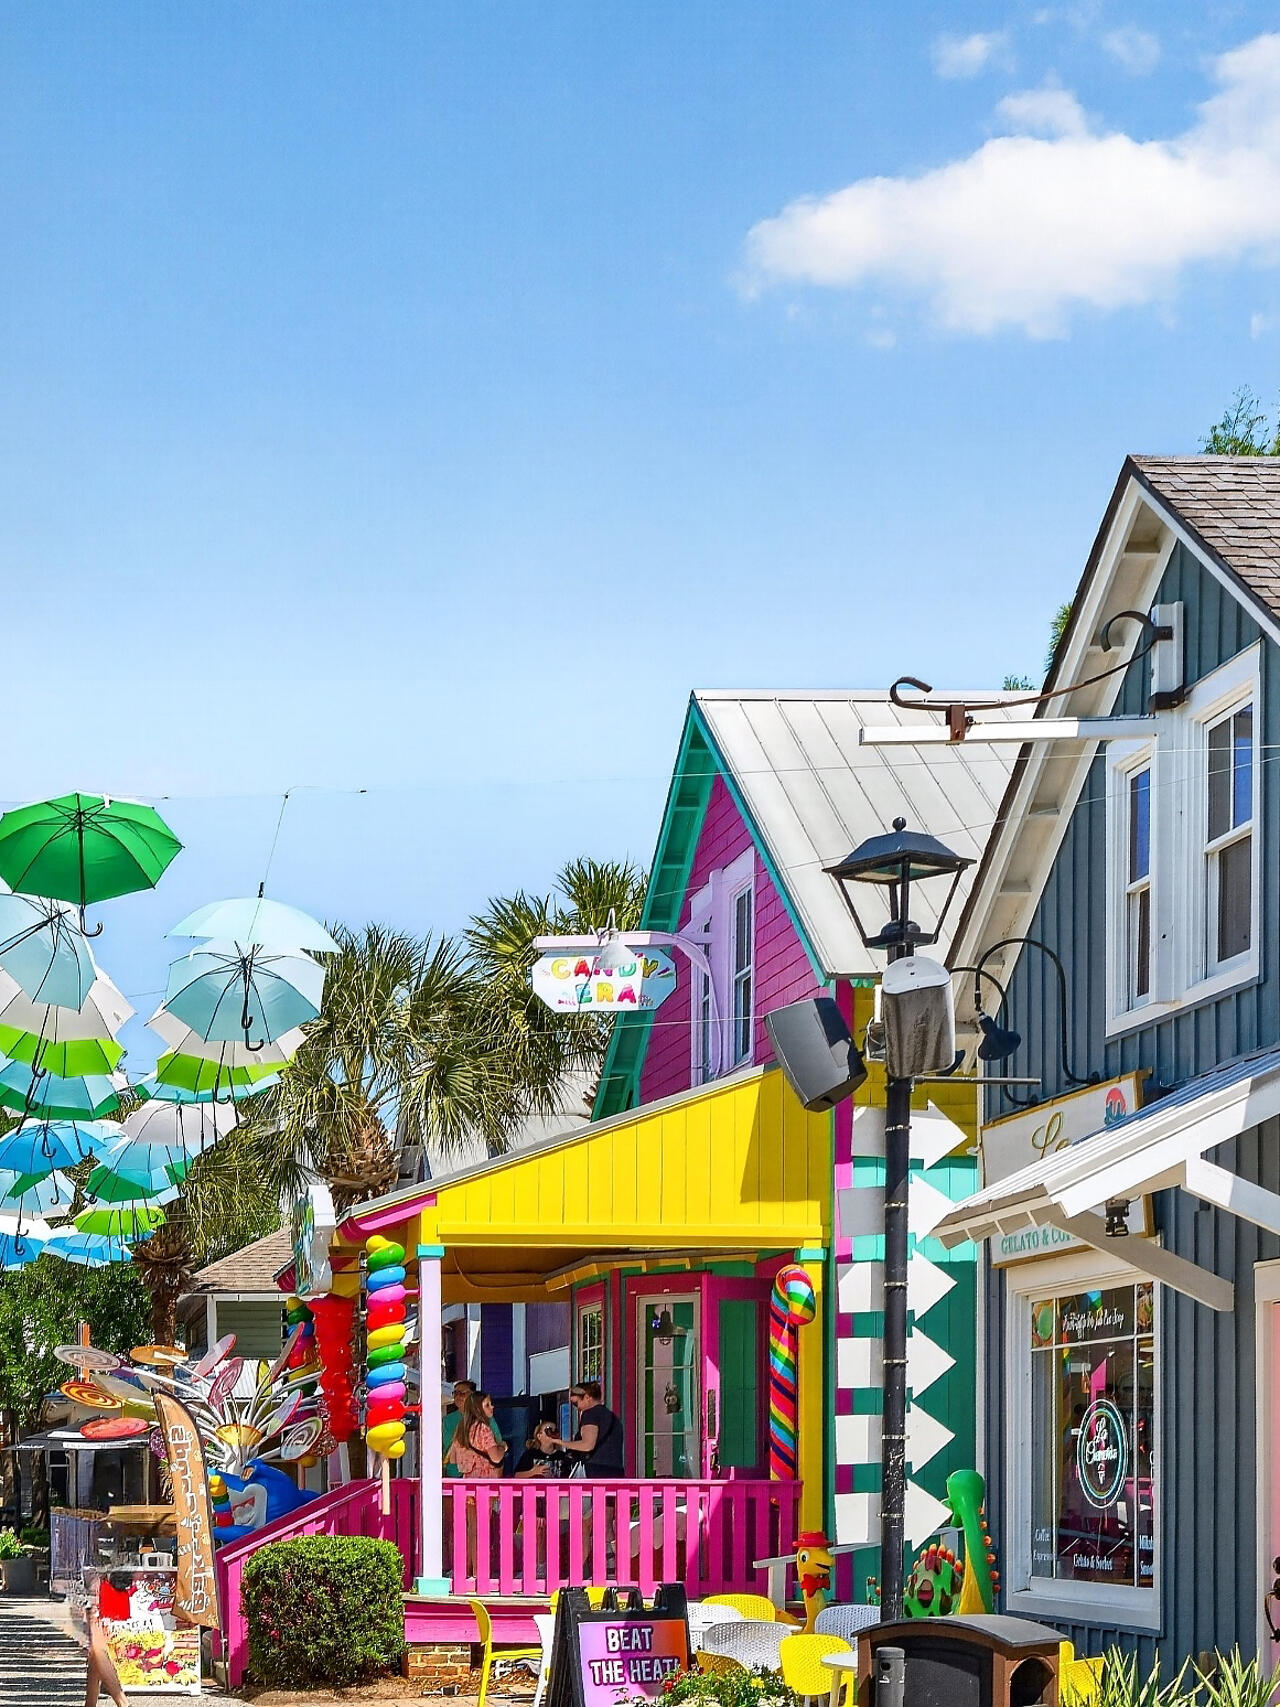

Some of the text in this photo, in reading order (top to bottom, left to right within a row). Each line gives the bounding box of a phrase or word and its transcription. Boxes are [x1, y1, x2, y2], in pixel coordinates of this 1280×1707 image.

[575, 982, 637, 1004] ERA
[1001, 1232, 1039, 1255] GELATO
[1042, 1230, 1049, 1246] &
[606, 1627, 652, 1652] BEAT
[589, 1660, 625, 1684] THE
